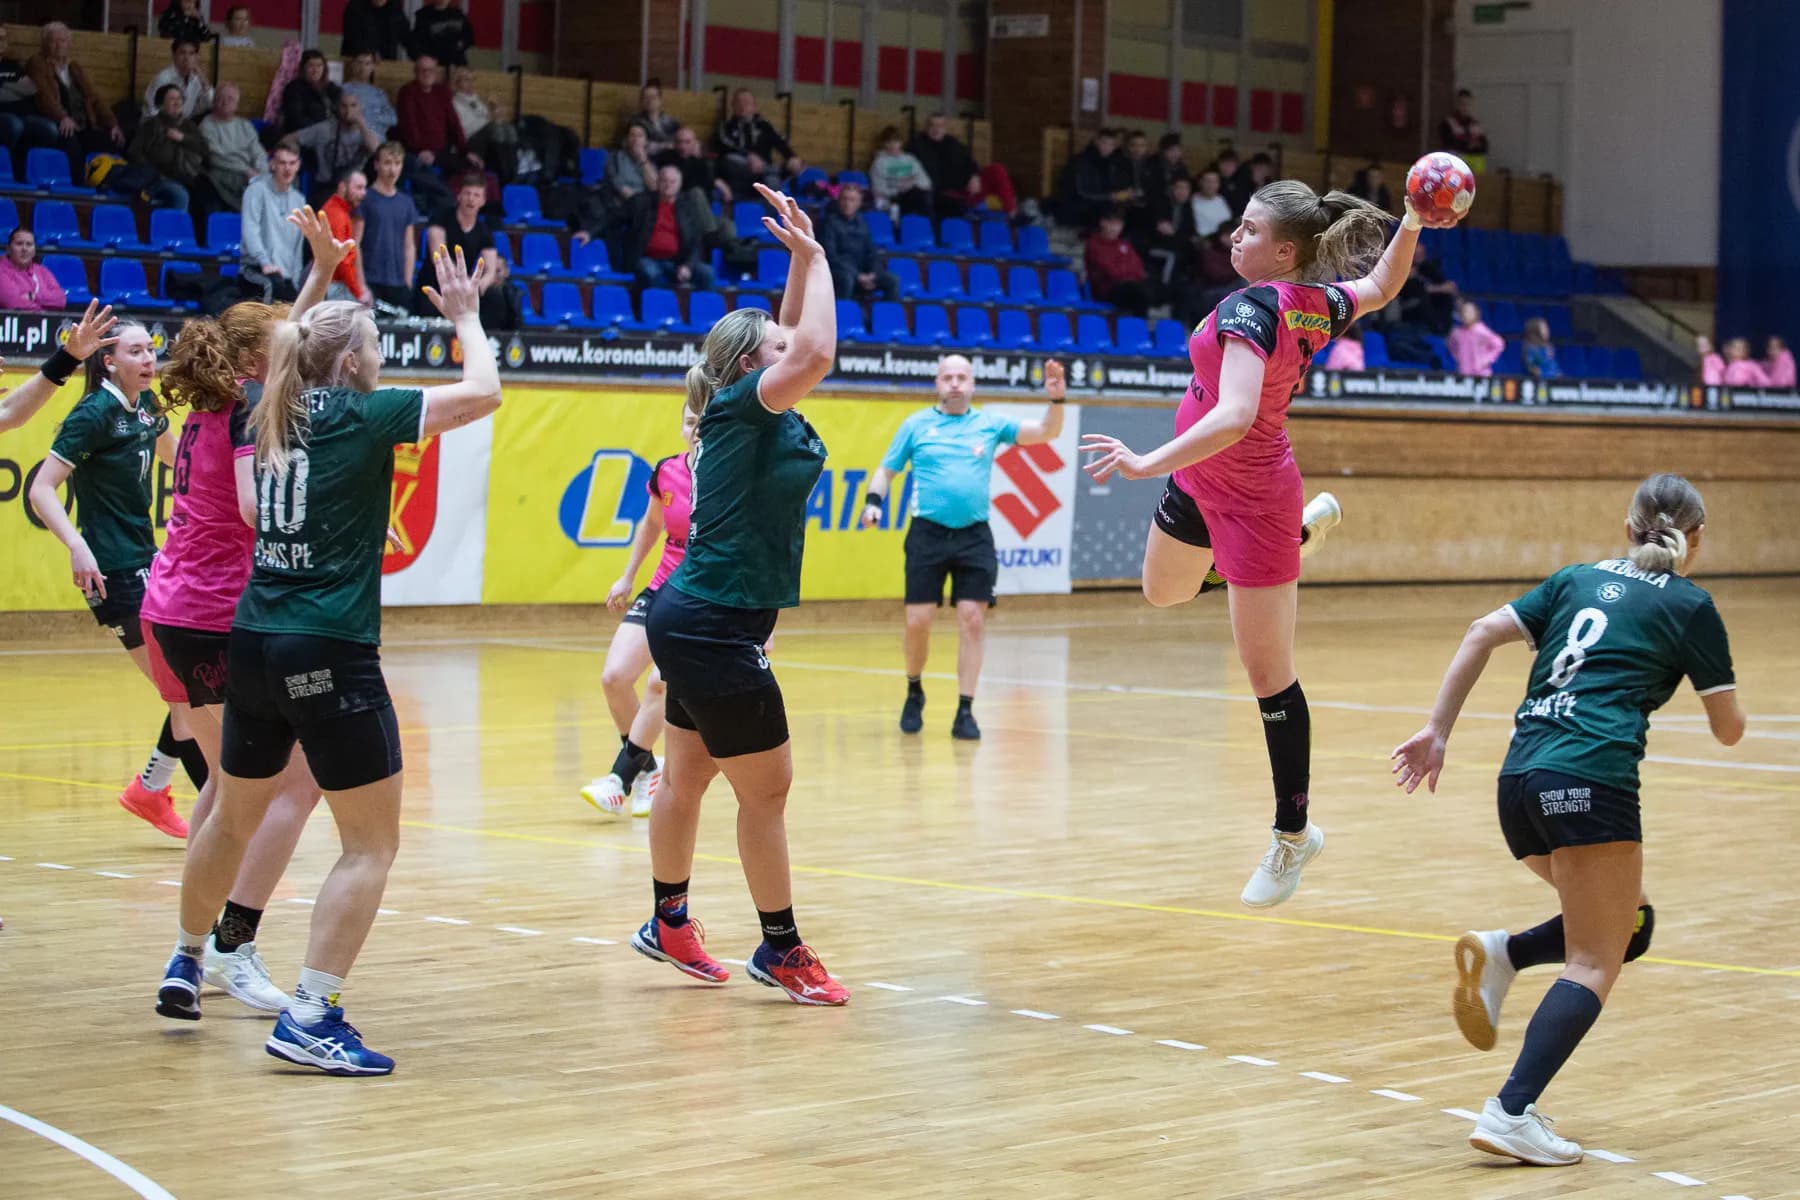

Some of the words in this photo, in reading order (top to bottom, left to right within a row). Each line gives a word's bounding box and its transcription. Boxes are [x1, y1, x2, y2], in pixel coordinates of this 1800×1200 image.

[1221, 317, 1262, 333] PROFIKA
[260, 449, 310, 534] 10
[1547, 607, 1608, 688] 8
[1539, 789, 1565, 803] SHOW
[1567, 787, 1591, 799] YOUR
[1541, 800, 1590, 816] STRENGTH
